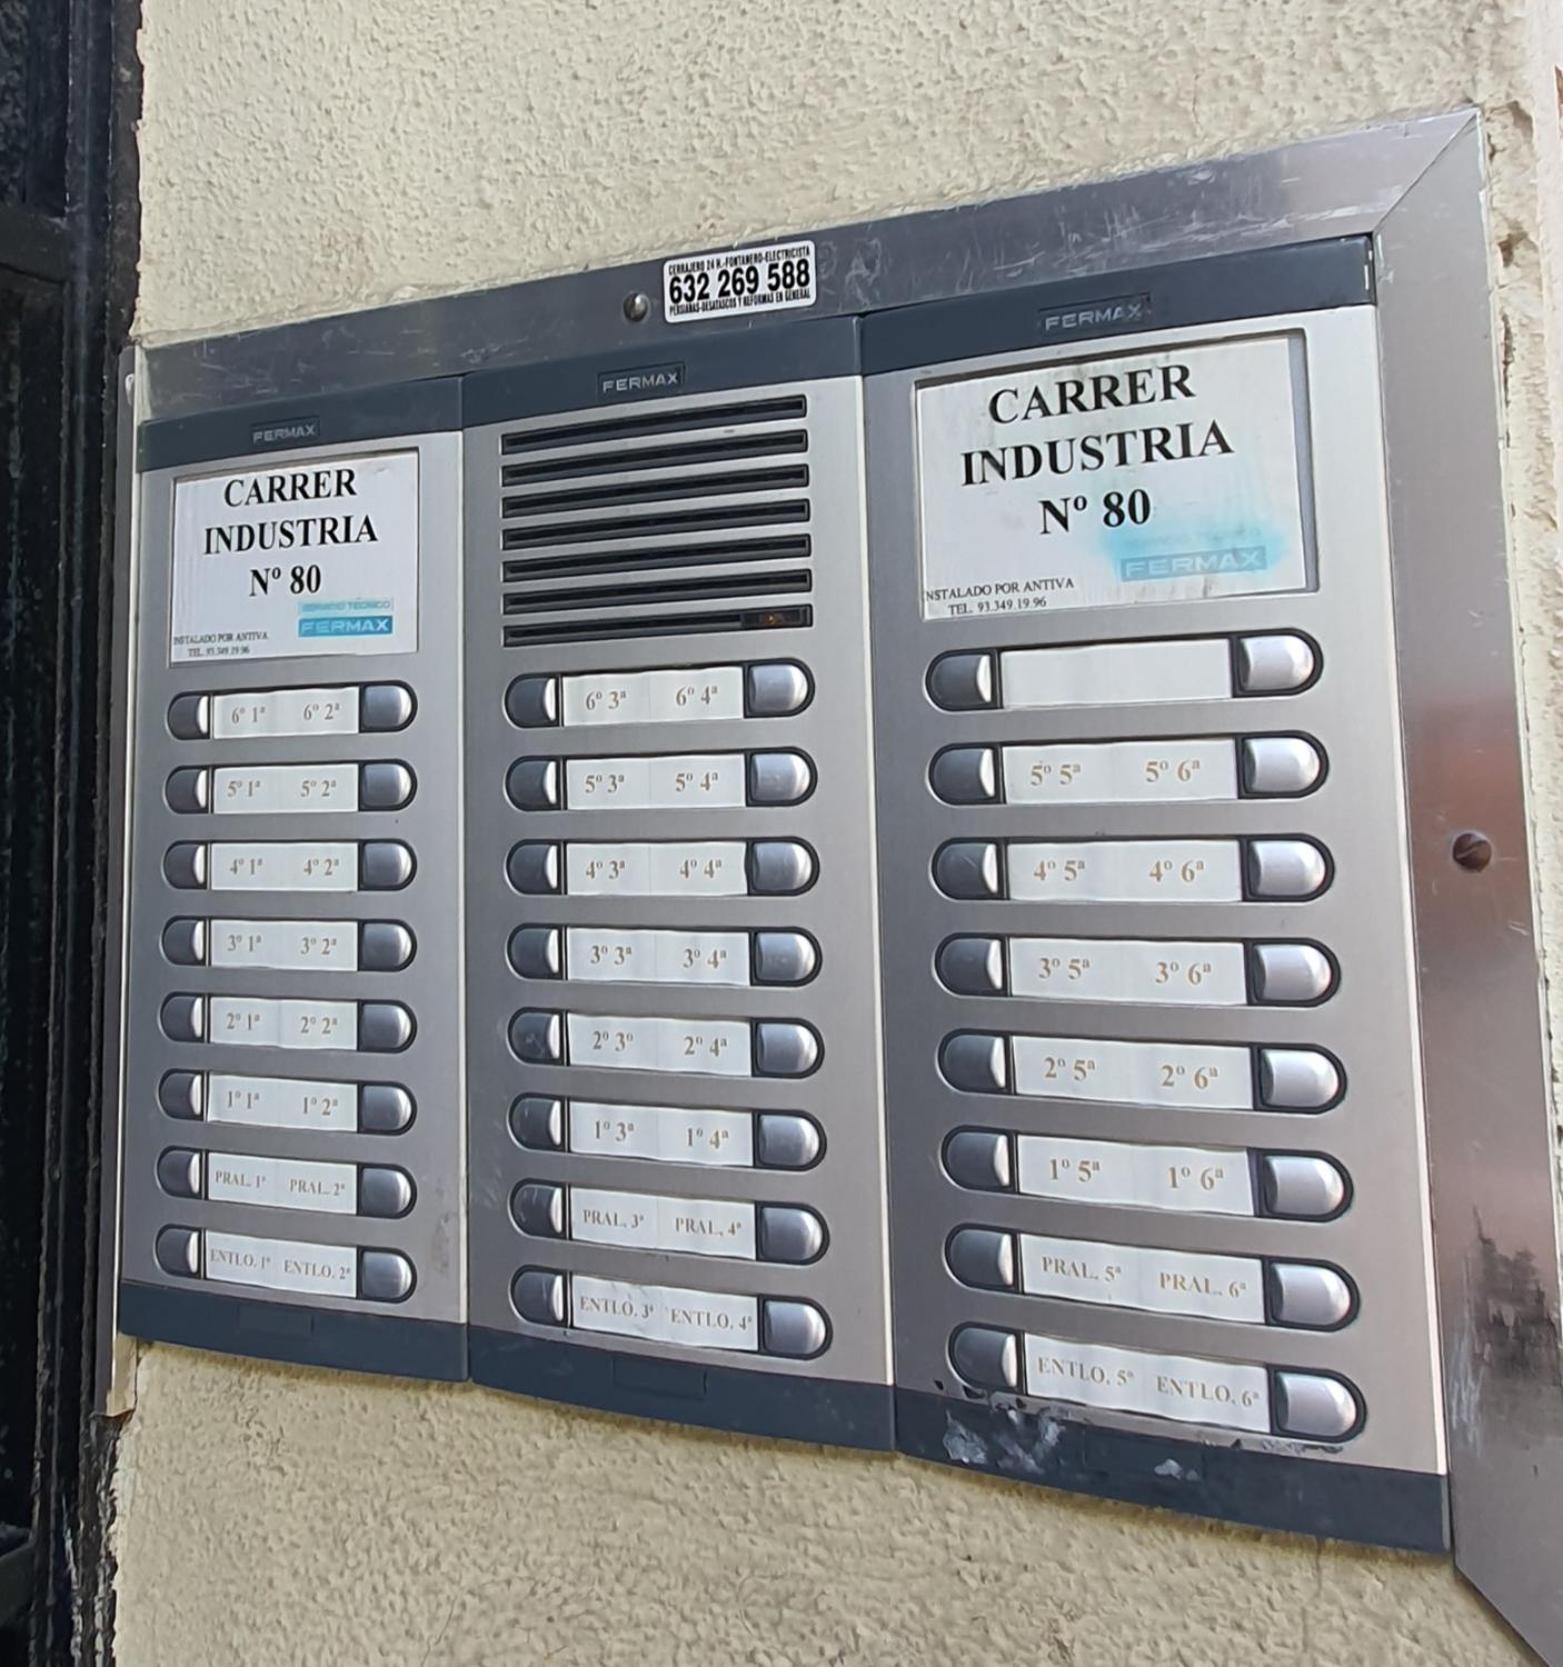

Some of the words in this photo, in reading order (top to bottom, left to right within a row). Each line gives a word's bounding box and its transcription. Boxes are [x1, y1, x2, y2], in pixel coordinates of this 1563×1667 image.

[668, 261, 705, 276] CERRAJERO
[706, 259, 715, 271] 24
[669, 272, 710, 304] 632
[717, 265, 759, 298] 269
[767, 258, 810, 291] 588
[737, 297, 742, 308] Y
[743, 294, 774, 307] REFORMAS
[775, 292, 783, 303] EN
[785, 288, 811, 301] GENERAL
[1045, 303, 1143, 331] FERMAX
[602, 372, 678, 393] FERMAX
[988, 363, 1197, 424] CARRER
[253, 424, 316, 443] FERMAX
[960, 419, 1235, 487] INDUSTRIA
[223, 468, 357, 508] CARRER
[1039, 494, 1087, 535] Nº
[1102, 488, 1152, 528] 80
[203, 513, 379, 555] INDUSTRIA
[1125, 551, 1262, 577] FERMAX
[249, 567, 281, 597] Nº
[289, 564, 322, 595] 80
[925, 584, 993, 602] NSTALADO
[995, 582, 1020, 595] POR
[1023, 577, 1075, 592] ANTIVA
[948, 602, 974, 616] TEL.
[217, 632, 233, 643] POR
[236, 631, 268, 642] ANTIVA
[301, 618, 390, 635] FERMAX
[188, 647, 204, 657] TEL.
[585, 691, 602, 711] 6º
[608, 690, 627, 710] 3ª
[675, 686, 695, 706] 6º
[700, 685, 718, 705] 4ª
[231, 707, 245, 724] 6º
[303, 704, 319, 720] 6º
[675, 773, 693, 792] 5º
[700, 772, 718, 792] 4ª
[1030, 763, 1051, 786] 5º
[1059, 763, 1081, 785] 5ª
[1145, 761, 1168, 783] 5º
[1177, 760, 1200, 782] 6ª
[227, 780, 243, 797] 5º
[300, 780, 317, 797] 5º
[585, 774, 602, 794] 5º
[607, 774, 625, 793] 3ª
[229, 858, 244, 875] 4º
[303, 858, 319, 876] 4º
[585, 860, 603, 880] 4º
[608, 860, 625, 880] 3ª
[679, 859, 697, 879] 4º
[704, 859, 722, 878] 4ª
[1033, 860, 1056, 881] 4º
[1064, 860, 1085, 882] 5ª
[1149, 860, 1172, 882] 4º
[1181, 860, 1204, 882] 6ª
[227, 934, 242, 952] 3º
[300, 937, 317, 954] 3º
[590, 945, 608, 965] 3º
[614, 946, 632, 966] 3ª
[683, 949, 701, 969] 3º
[707, 949, 727, 969] 4ª
[1038, 957, 1060, 979] 3º
[1068, 958, 1090, 980] 5ª
[1155, 962, 1179, 984] 3º
[1188, 963, 1212, 985] 6ª
[227, 1012, 241, 1030] 2º
[301, 1016, 317, 1034] 2º
[592, 1030, 609, 1050] 2º
[684, 1036, 703, 1055] 2º
[709, 1037, 727, 1057] 4ª
[1044, 1057, 1066, 1078] 2º
[1073, 1059, 1095, 1081] 5ª
[1161, 1064, 1185, 1087] 2º
[1194, 1067, 1218, 1090] 6ª
[227, 1090, 241, 1108] 1º
[303, 1096, 317, 1114] 1º
[595, 1120, 610, 1139] 1º
[616, 1122, 634, 1142] 3ª
[687, 1128, 703, 1146] 1º
[709, 1129, 729, 1149] 4ª
[215, 1169, 251, 1187] PRAL.
[1049, 1158, 1070, 1180] 1º
[1078, 1160, 1100, 1182] 5ª
[1168, 1166, 1191, 1188] 1º
[1200, 1167, 1223, 1191] 6ª
[289, 1178, 330, 1195] PRAL.
[583, 1208, 628, 1229] PRAL.
[675, 1217, 723, 1237] PRAL.
[210, 1248, 257, 1268] ENTLO.
[1041, 1256, 1099, 1280] PRAL.
[284, 1259, 336, 1280] ENTLO.
[1160, 1272, 1222, 1296] PRAL.
[580, 1297, 638, 1318] ENTLO.
[671, 1308, 734, 1330] ENTLO.
[1038, 1356, 1110, 1385] ENTLO.
[1157, 1376, 1236, 1404] ENTLO.
